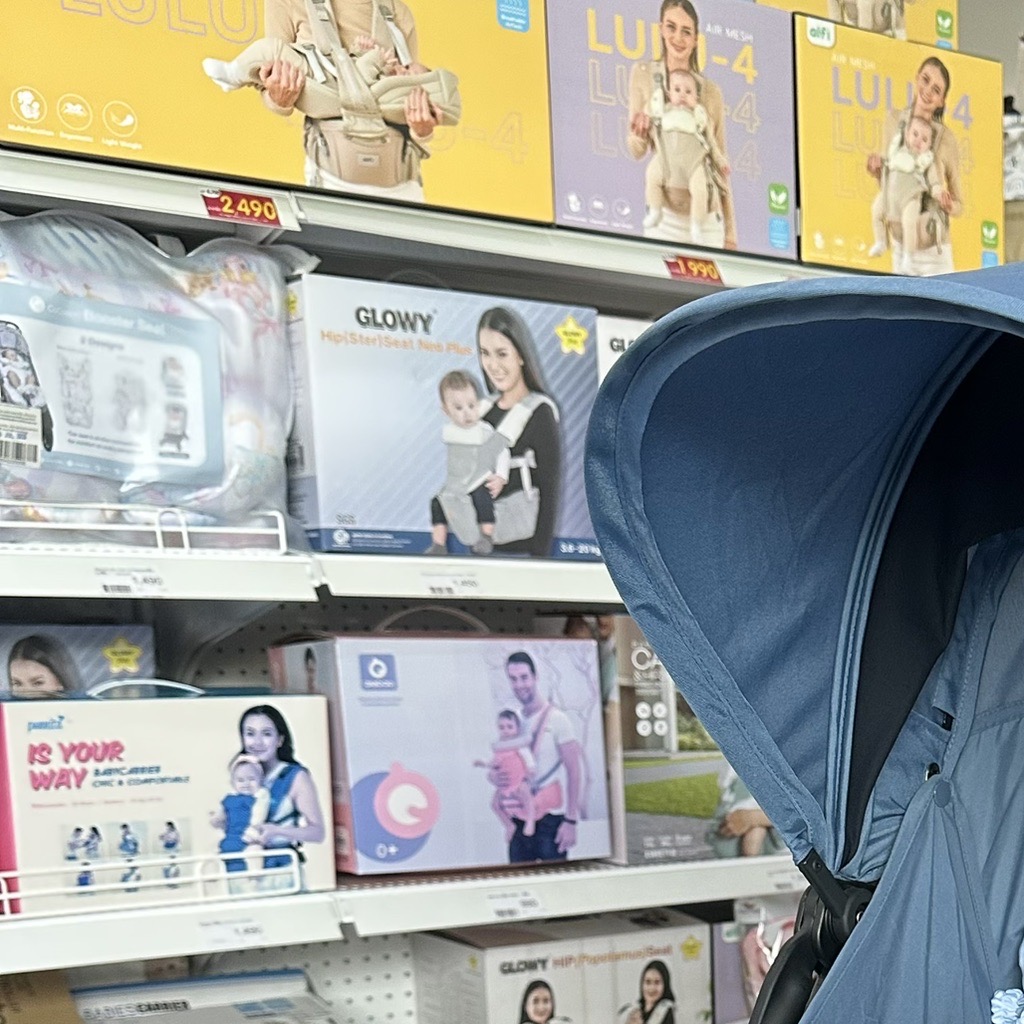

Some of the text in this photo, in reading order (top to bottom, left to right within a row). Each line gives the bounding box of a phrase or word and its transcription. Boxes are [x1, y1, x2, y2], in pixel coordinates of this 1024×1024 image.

[355, 306, 434, 335] GLOWY
[28, 740, 125, 765] IS YOUR
[29, 768, 88, 791] WAY
